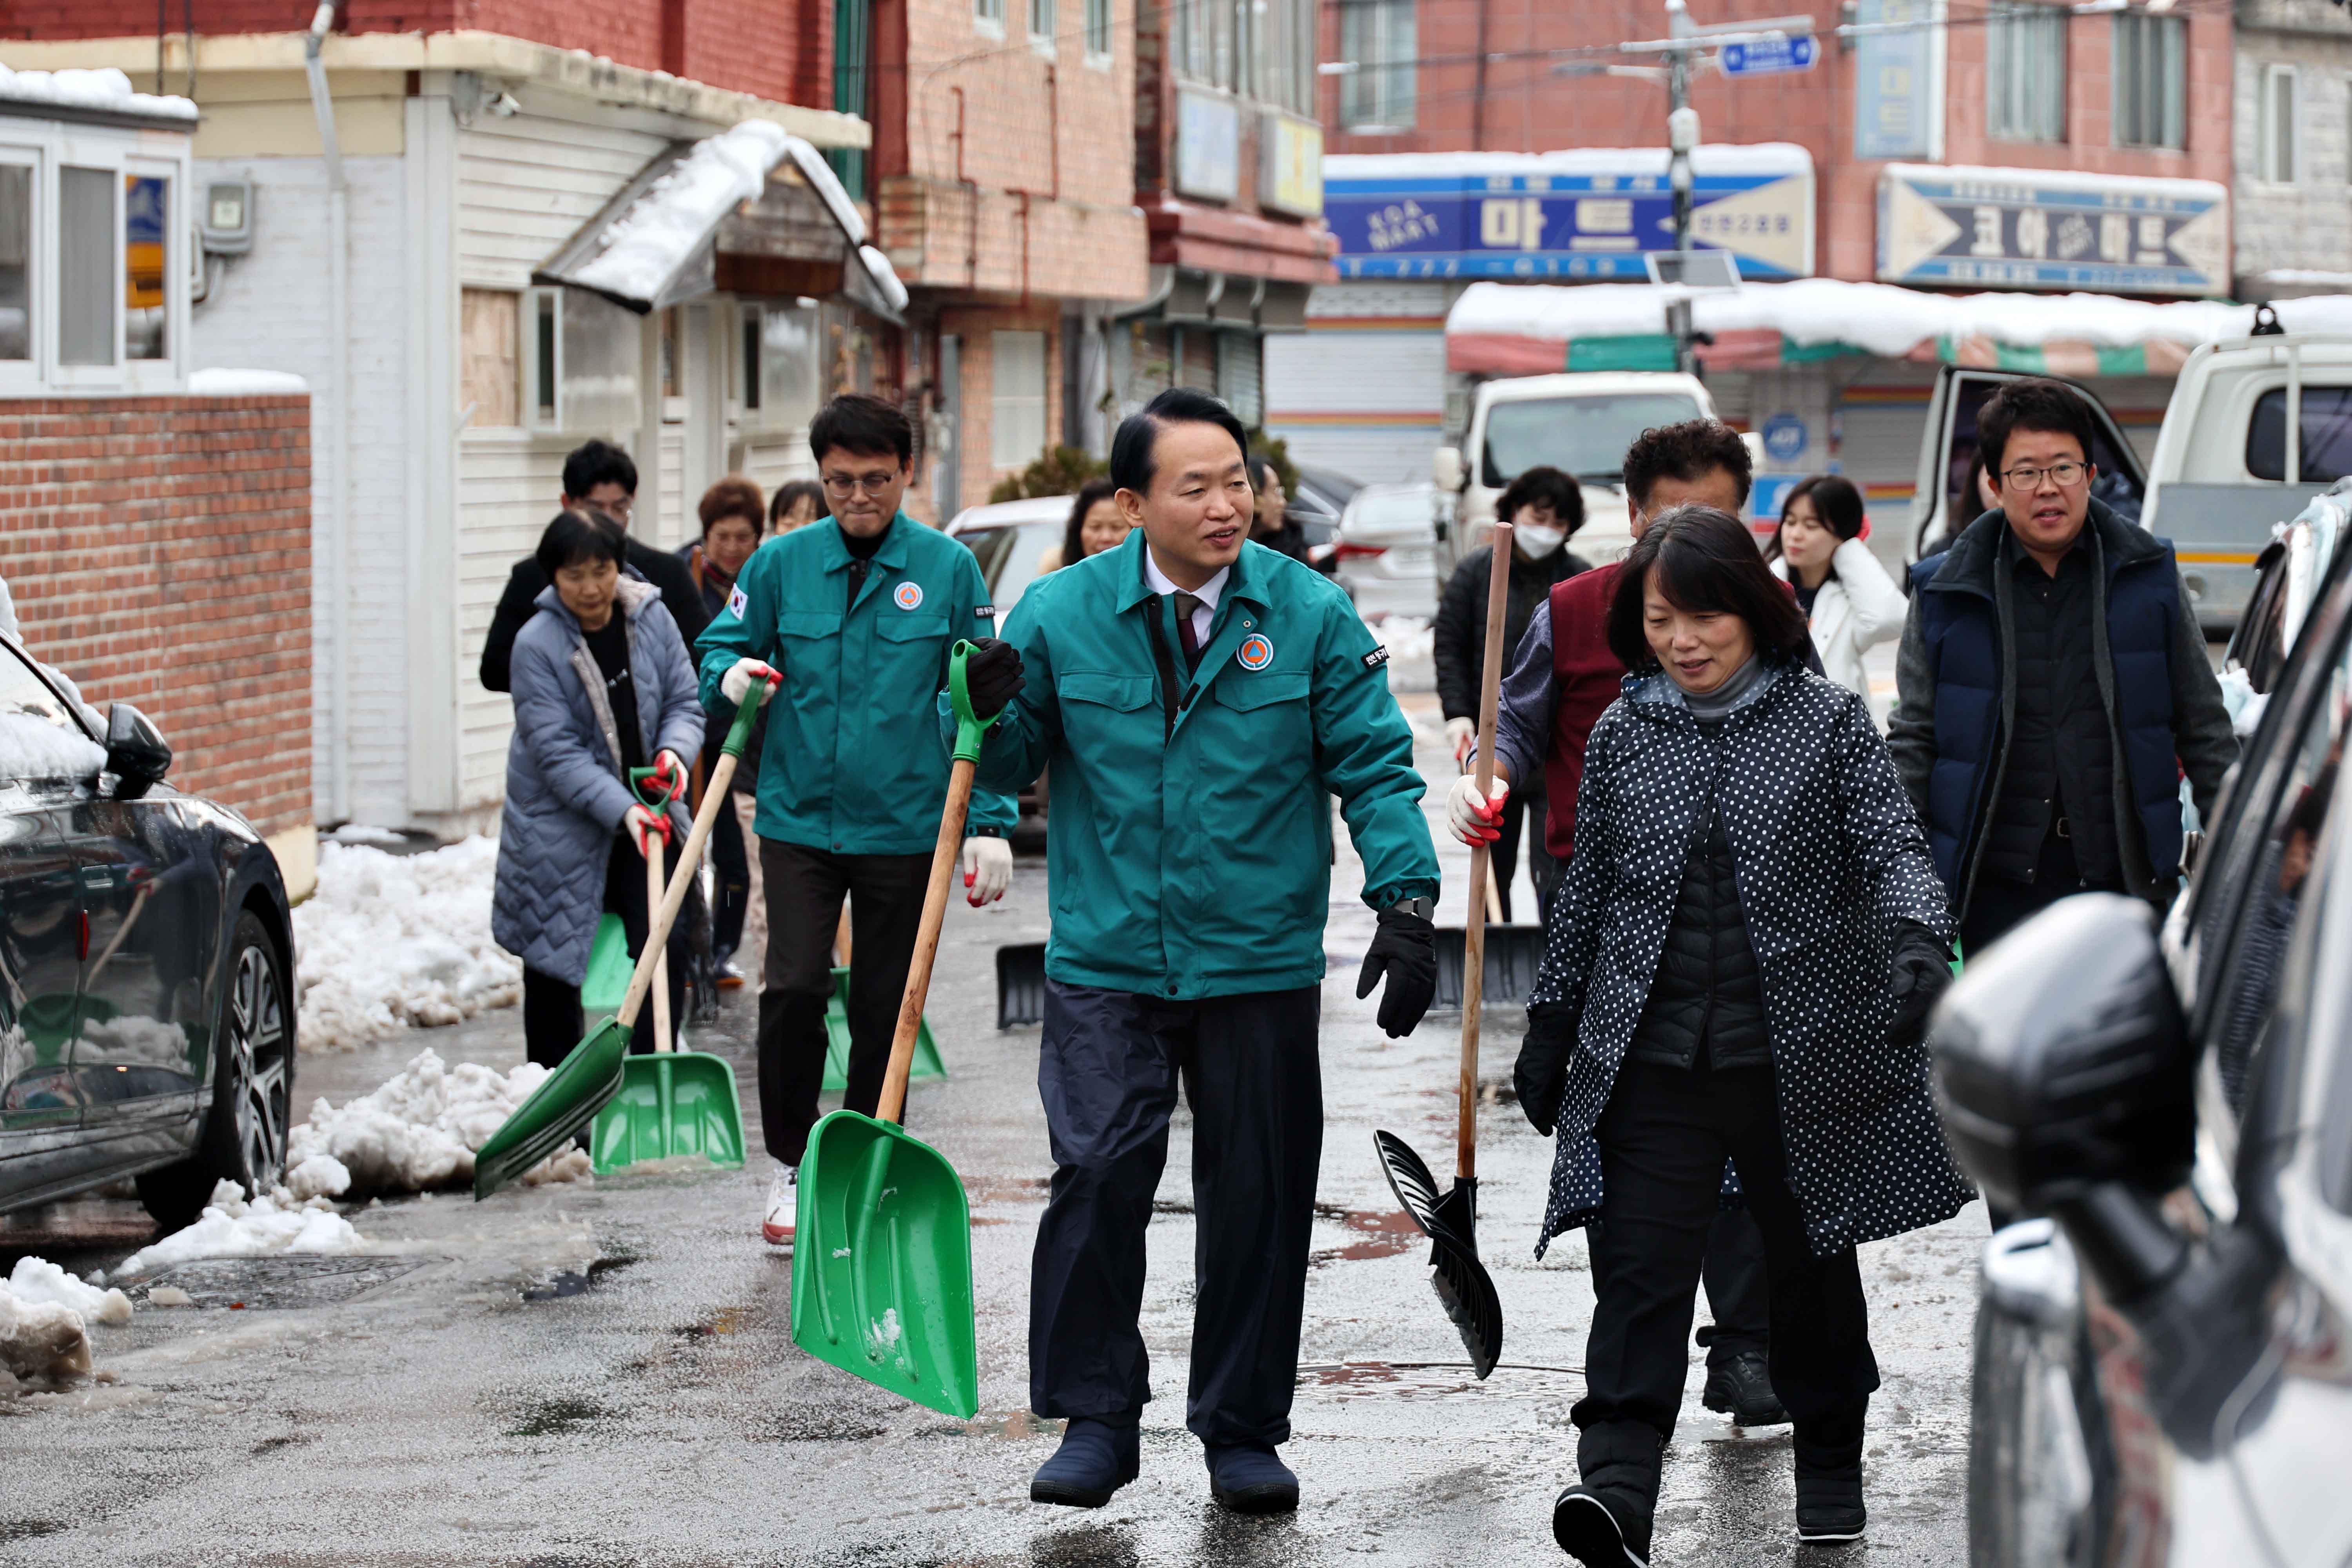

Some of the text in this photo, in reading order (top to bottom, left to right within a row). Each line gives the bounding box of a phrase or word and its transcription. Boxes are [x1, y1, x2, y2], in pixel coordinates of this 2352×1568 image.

[1480, 197, 1640, 252] 마트
[2099, 212, 2168, 265] 마트
[1366, 653, 1377, 665] 인천
